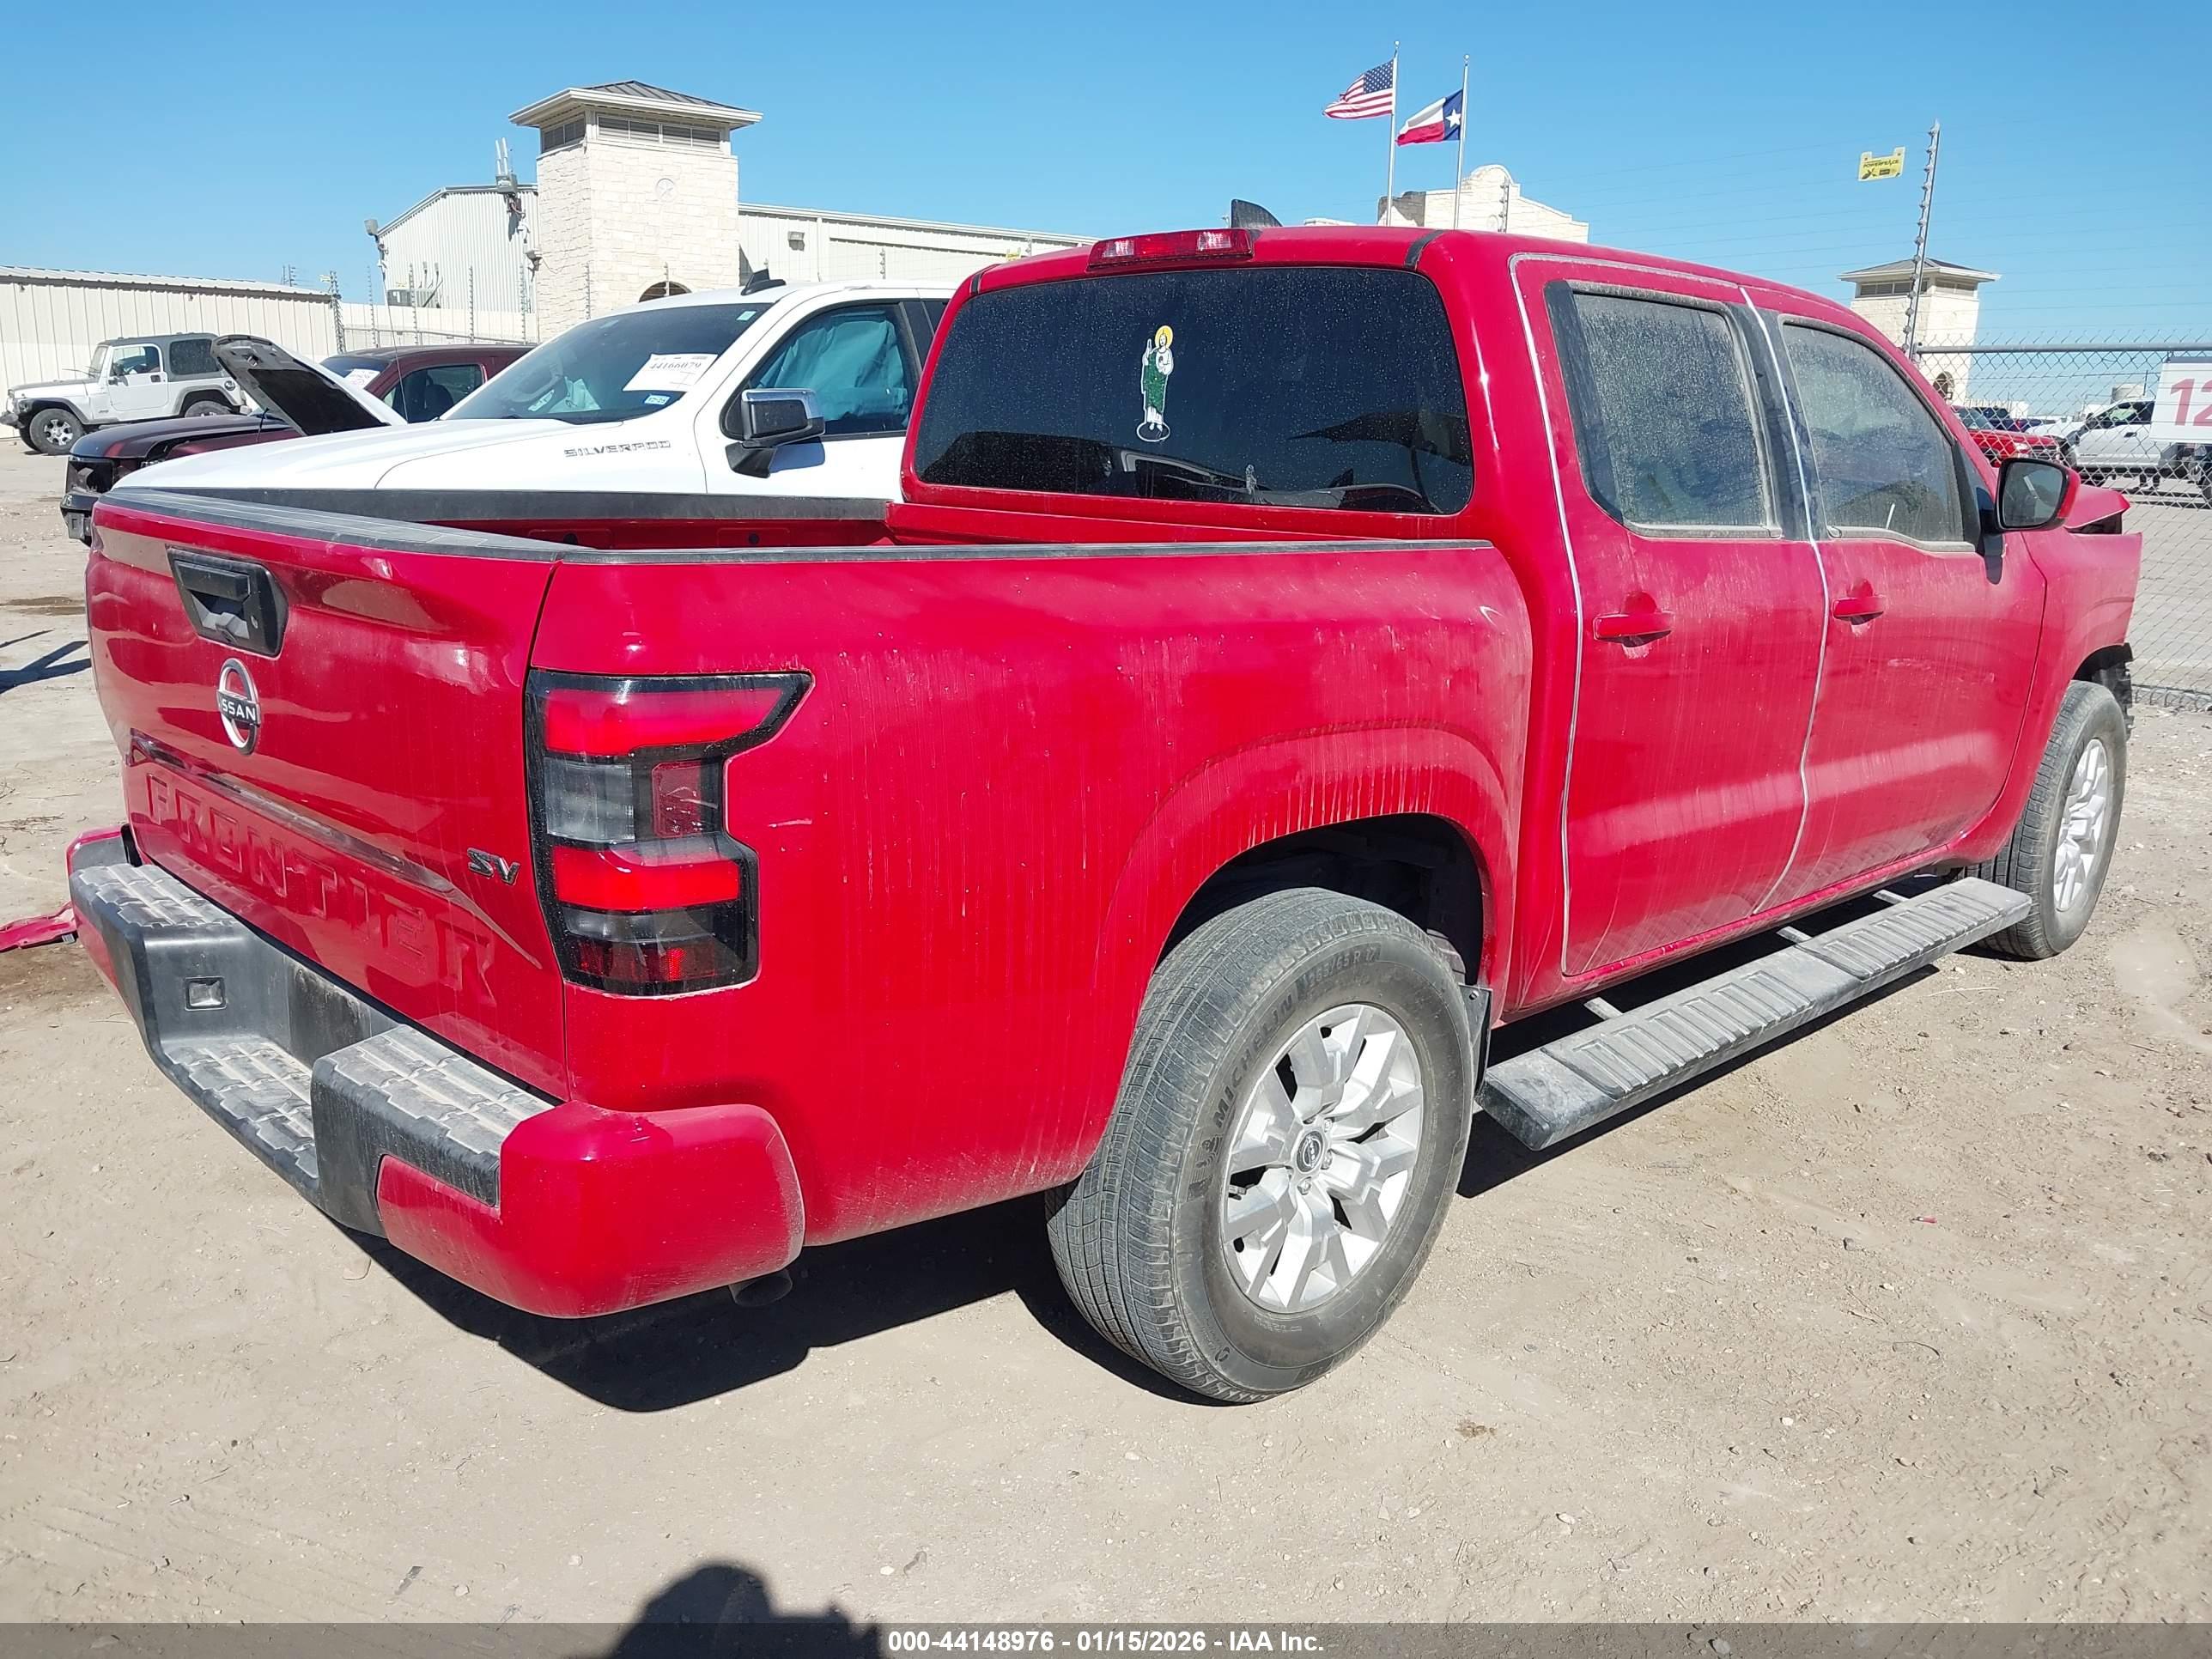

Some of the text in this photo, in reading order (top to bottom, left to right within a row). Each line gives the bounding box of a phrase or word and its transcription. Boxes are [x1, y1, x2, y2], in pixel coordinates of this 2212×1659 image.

[146, 773, 498, 1007] FRONTIER
[466, 847, 520, 885] SV
[1212, 994, 1294, 1129] MICHELIN
